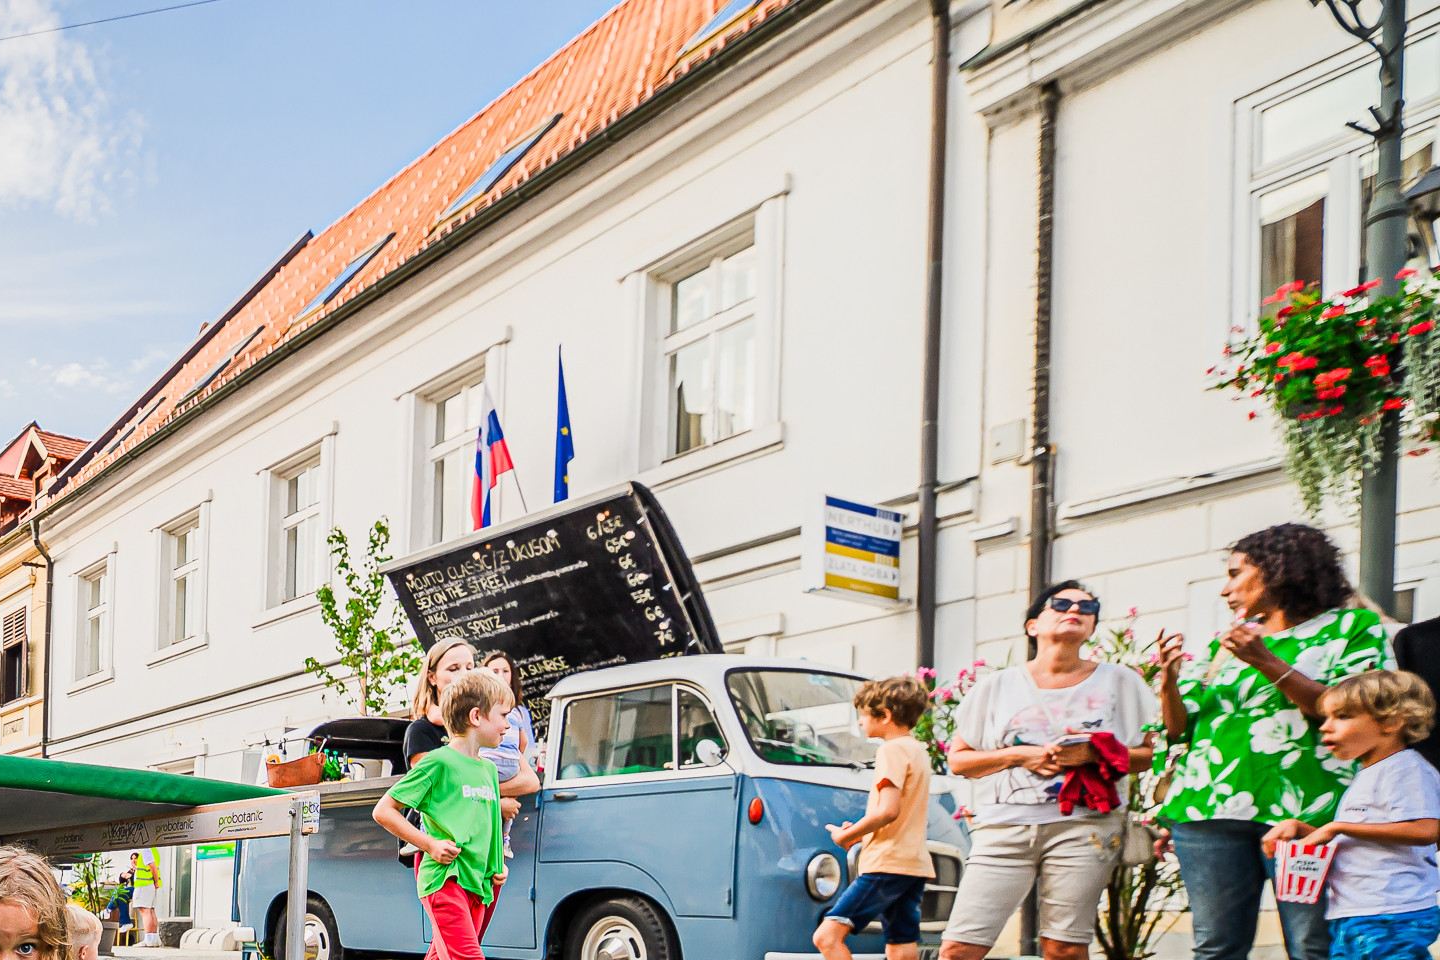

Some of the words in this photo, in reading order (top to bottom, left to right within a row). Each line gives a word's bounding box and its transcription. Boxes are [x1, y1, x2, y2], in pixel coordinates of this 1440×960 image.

[405, 569, 445, 593] MOJITO
[416, 595, 435, 611] SEX
[433, 591, 449, 606] ON
[445, 584, 468, 600] THE
[424, 611, 449, 627] HUGO
[644, 605, 665, 621] 6€
[467, 615, 506, 635] SPRITZ
[528, 656, 570, 675] SUNRISE
[155, 817, 195, 835] probotanic
[218, 809, 264, 828] probotanic
